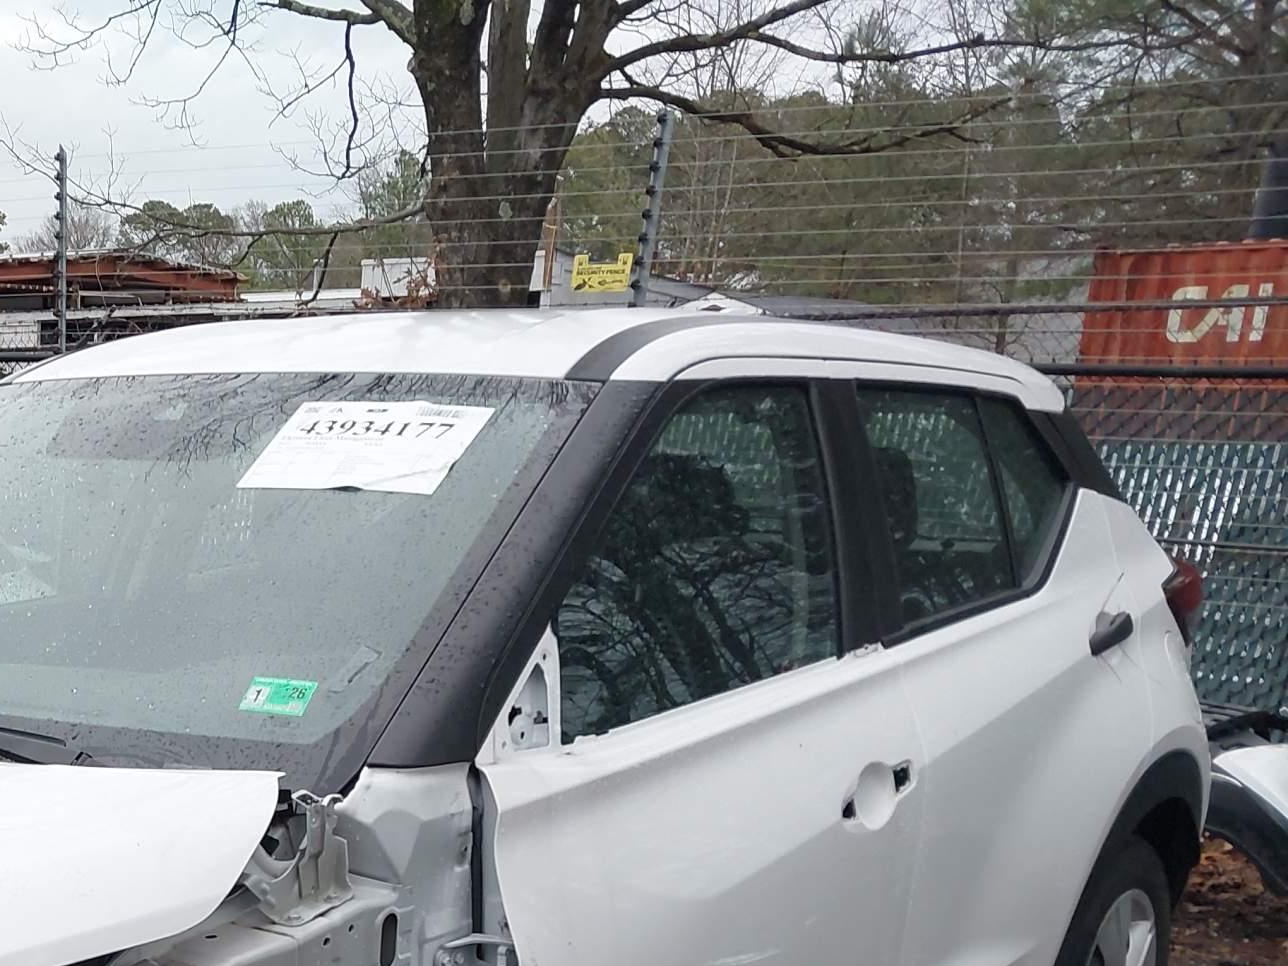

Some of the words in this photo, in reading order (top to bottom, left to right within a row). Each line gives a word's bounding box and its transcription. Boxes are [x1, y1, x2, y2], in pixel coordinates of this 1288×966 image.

[1165, 282, 1274, 343] CAI
[300, 420, 455, 438] 43934177
[252, 688, 263, 703] 1
[288, 686, 307, 700] 26
